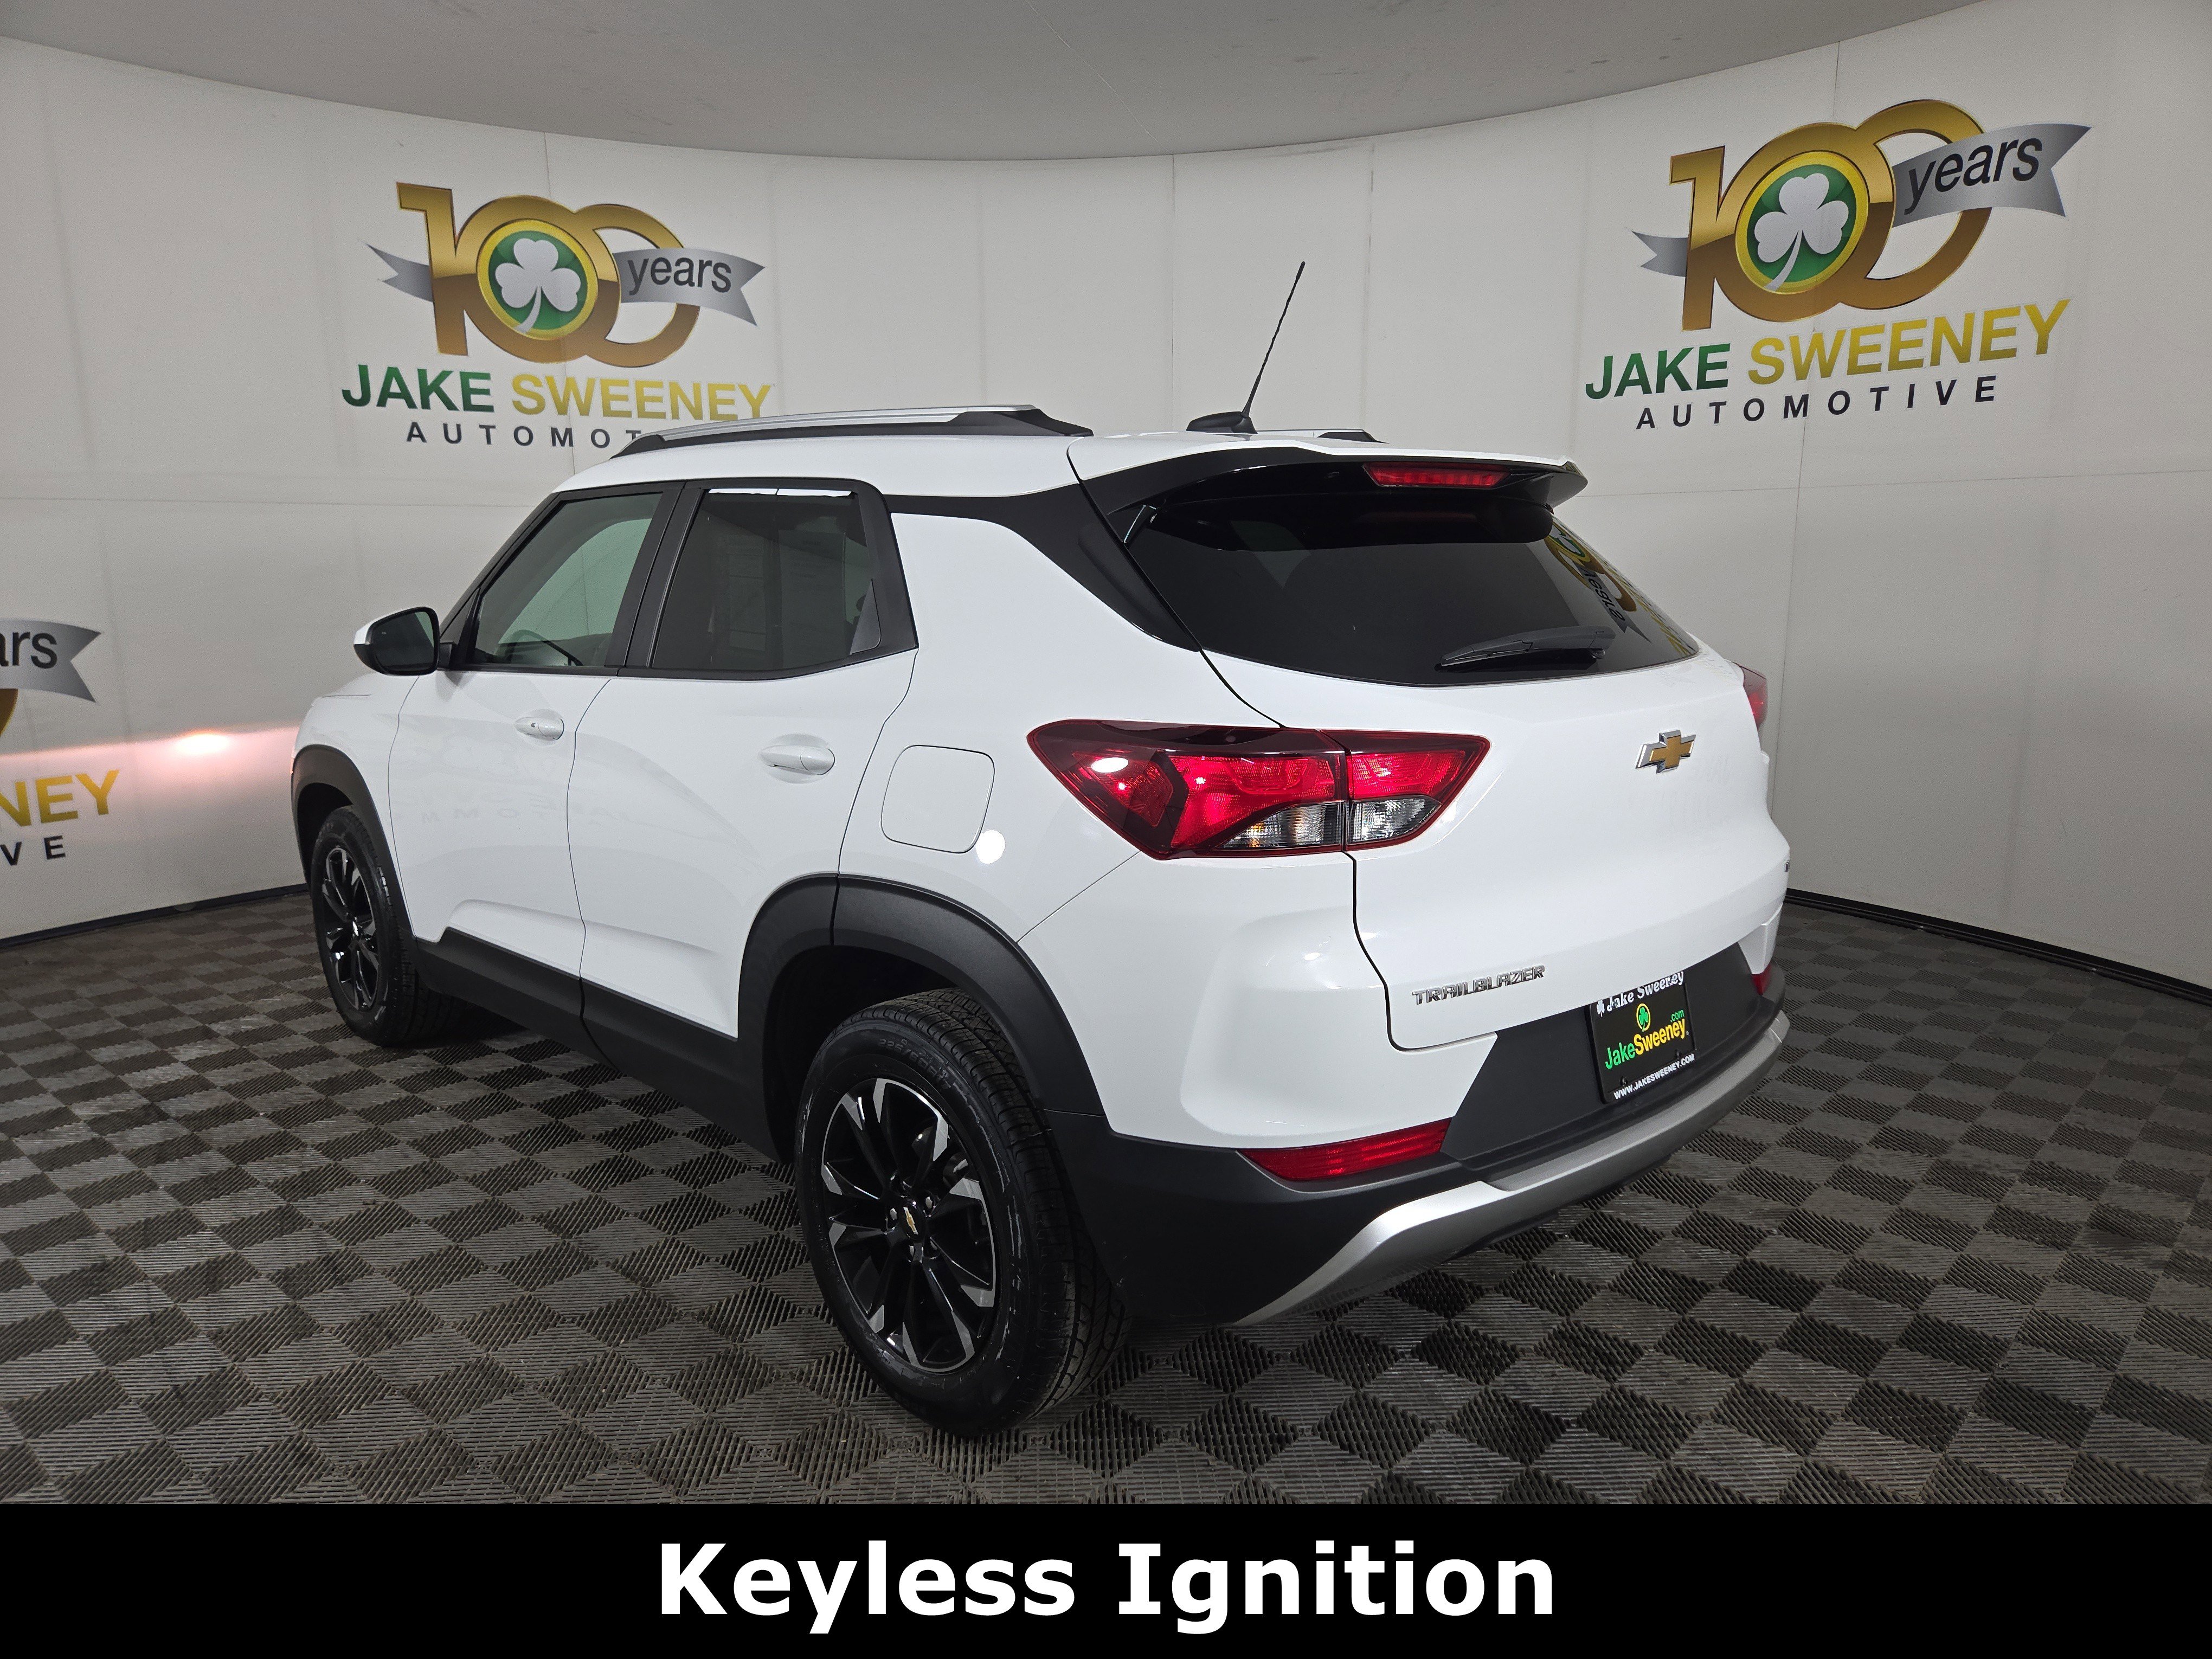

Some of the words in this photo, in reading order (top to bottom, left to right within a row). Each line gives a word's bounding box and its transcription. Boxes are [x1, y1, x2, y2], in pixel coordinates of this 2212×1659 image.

[1669, 99, 1992, 332] 100
[1904, 137, 2043, 215] years
[396, 182, 701, 368] 100
[627, 257, 732, 295] years
[1585, 343, 1731, 400] JAKE
[1748, 299, 2072, 384] SWEENEY
[342, 364, 494, 413] JAKE
[512, 374, 771, 421] SWEENEY
[1636, 375, 1996, 429] AUTOMOTIVE
[1412, 965, 1545, 1005] TRAILBLAZER
[1607, 992, 1635, 1012] Jake
[1637, 971, 1684, 999] Sweeney
[1670, 1009, 1685, 1023] .com
[1613, 1053, 1695, 1099] WWW.JAKESWEENEY.COM
